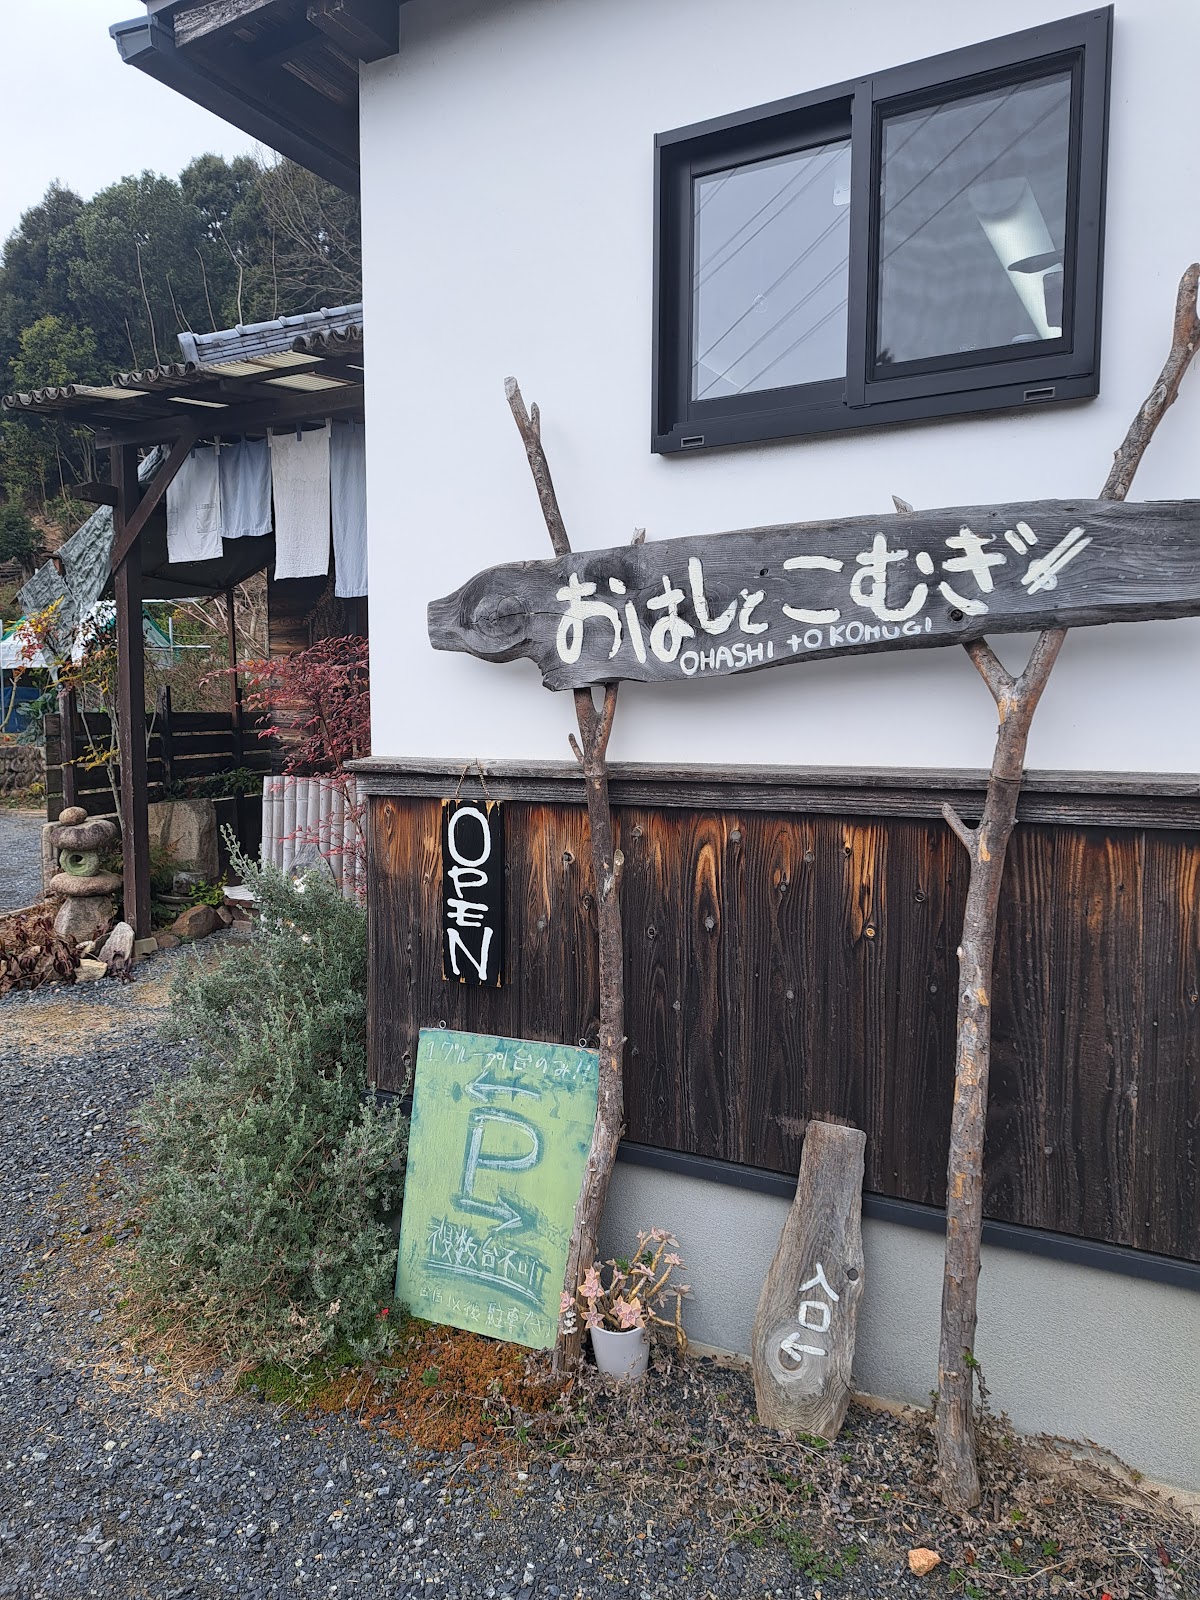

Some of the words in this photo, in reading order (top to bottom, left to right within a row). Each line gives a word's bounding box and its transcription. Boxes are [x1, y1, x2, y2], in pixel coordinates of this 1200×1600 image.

[680, 640, 774, 676] OHASHI
[829, 616, 933, 647] KOMUGI
[447, 806, 494, 982] OPEN
[461, 1112, 541, 1198] P
[798, 1261, 841, 1334] 入口
